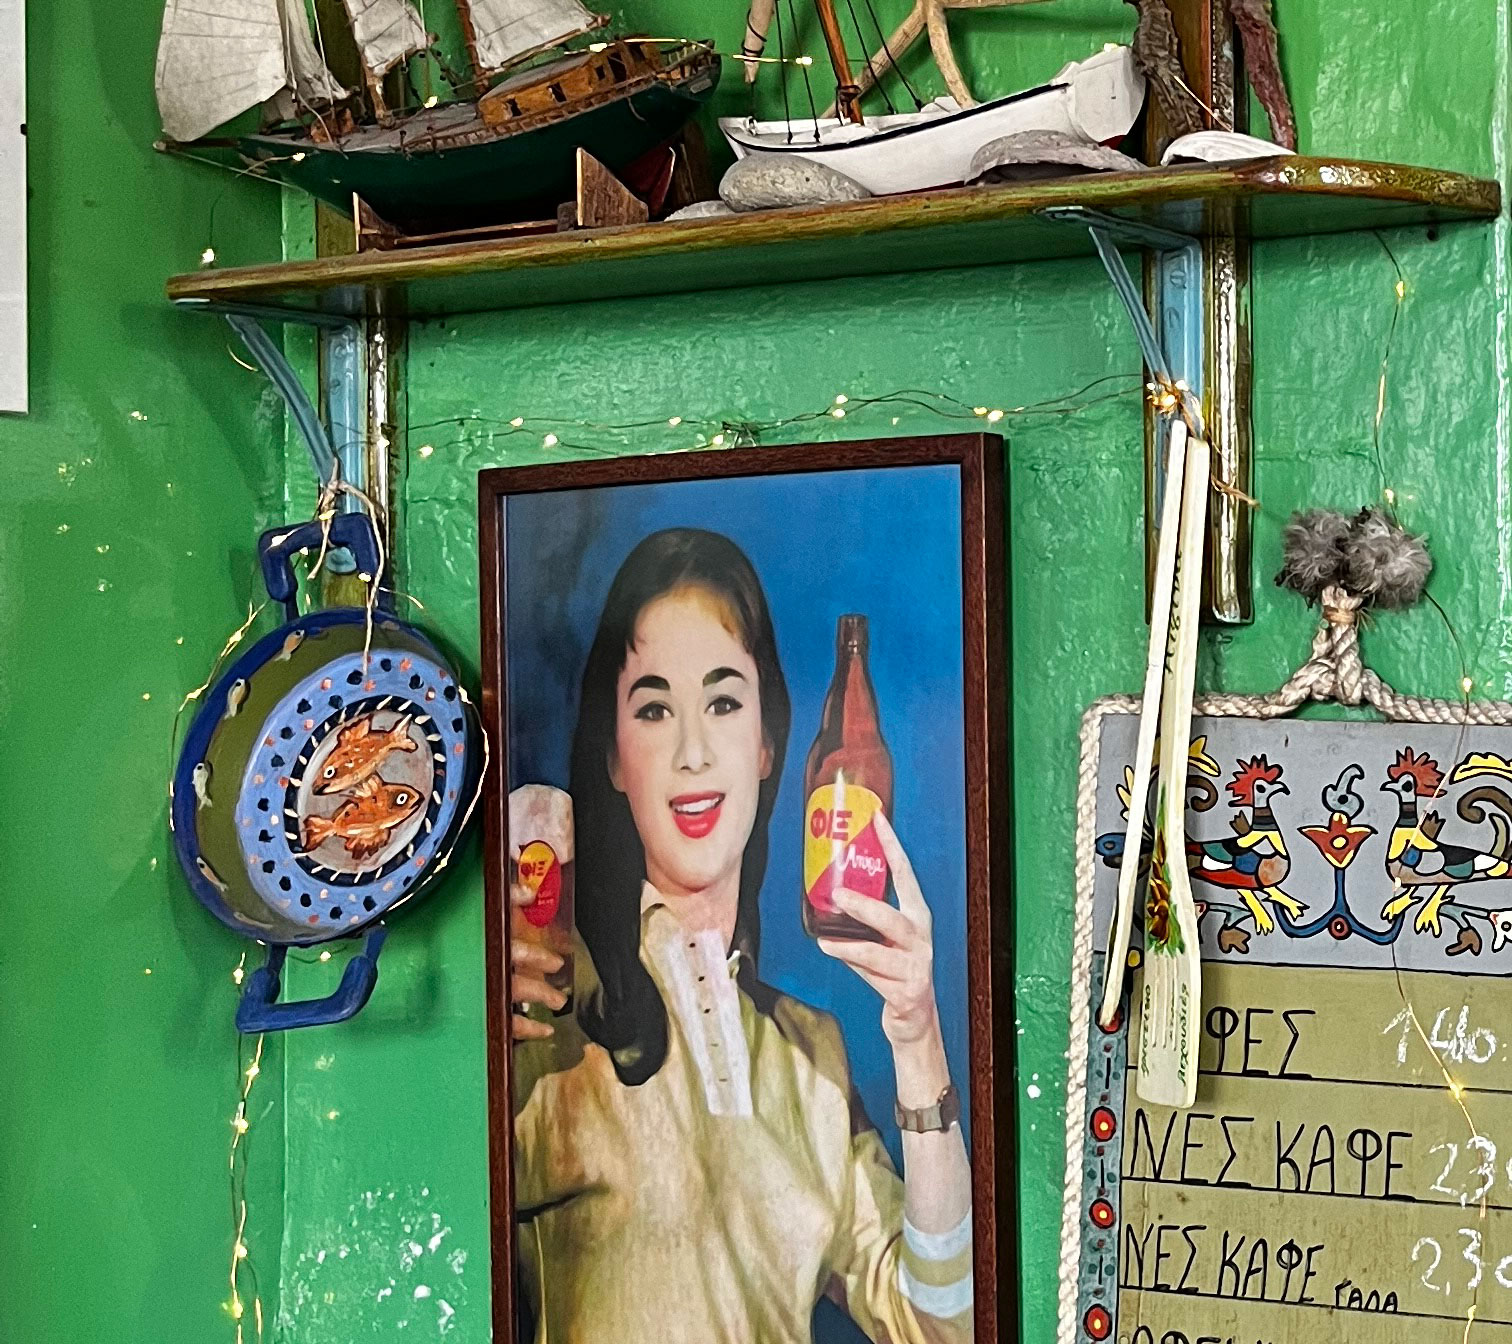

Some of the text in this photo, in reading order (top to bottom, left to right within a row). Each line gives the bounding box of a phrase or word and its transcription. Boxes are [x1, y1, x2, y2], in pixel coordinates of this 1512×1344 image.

[1130, 1108, 1255, 1187] ΝΕΣ
[1275, 1121, 1416, 1203] ΚΑΦΕ
[1122, 1223, 1208, 1294] ΝΕΣ
[1219, 1230, 1327, 1306] ΚΑΦΕ
